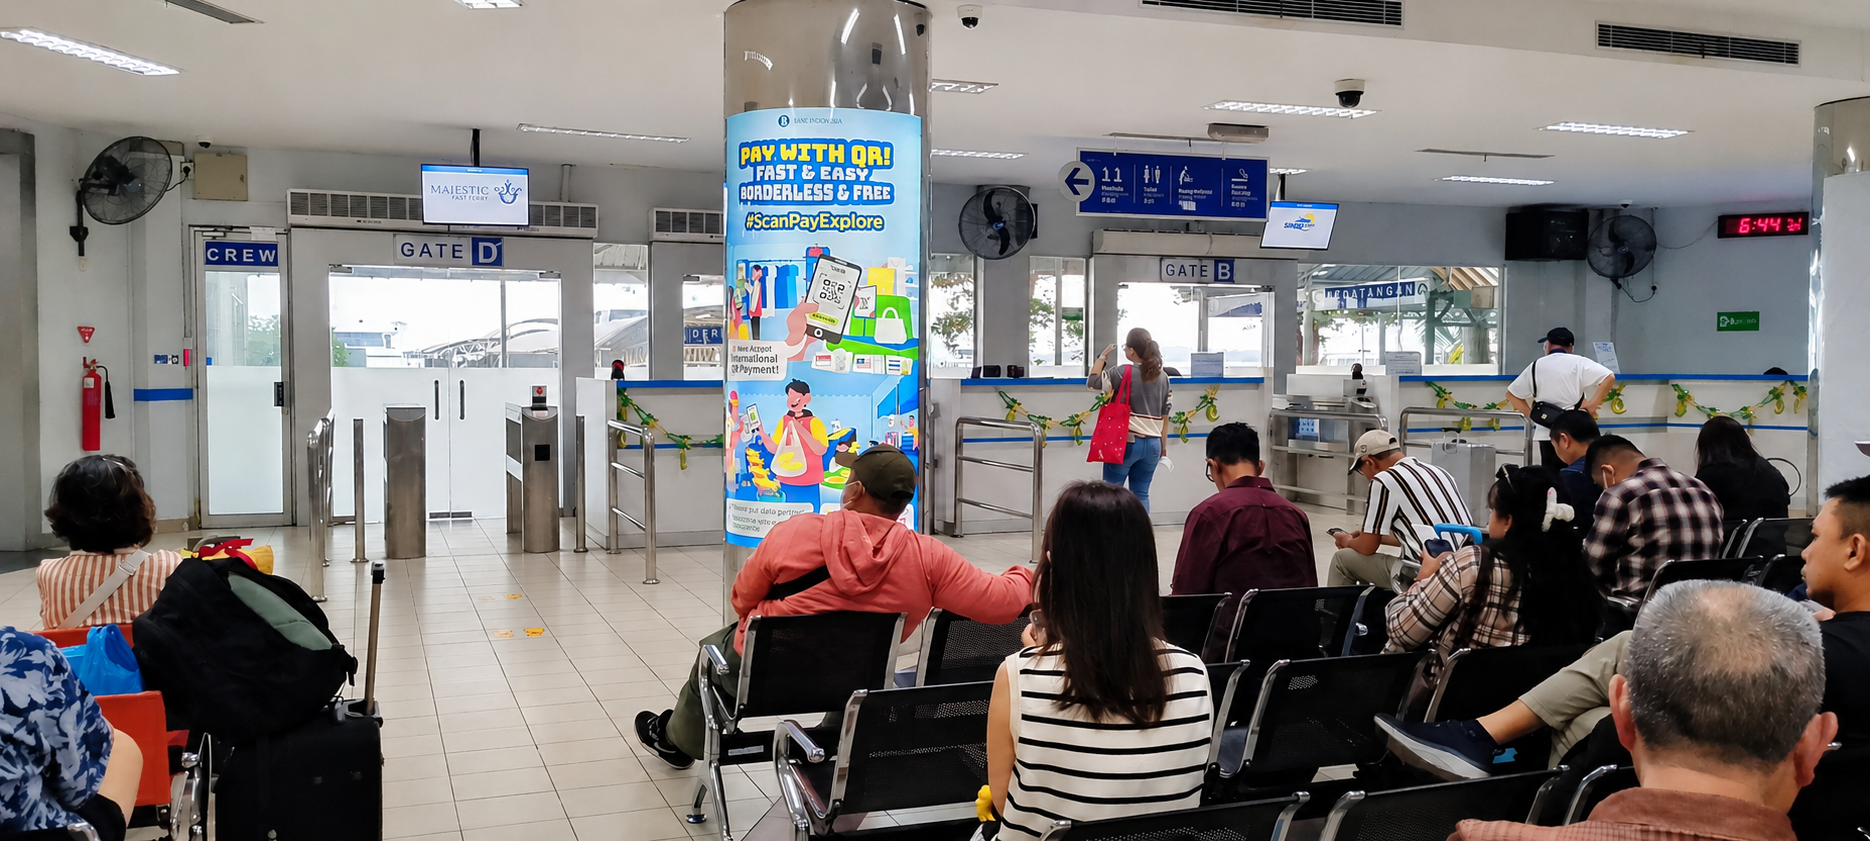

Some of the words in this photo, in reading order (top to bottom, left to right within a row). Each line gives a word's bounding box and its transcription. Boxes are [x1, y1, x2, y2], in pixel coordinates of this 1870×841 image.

[741, 144, 775, 165] PAY
[780, 143, 845, 163] WITH
[851, 145, 891, 168] QR!
[756, 165, 798, 182] FAST
[801, 164, 815, 180] &
[820, 166, 869, 181] EASY
[740, 184, 834, 201] BORDERLESS
[837, 184, 850, 201] &
[853, 184, 891, 201] FREE
[746, 212, 883, 231] #ScanPayExplore
[1739, 217, 1781, 234] 6:44
[206, 247, 276, 263] CREW
[401, 241, 463, 260] GATE
[478, 242, 499, 264] D
[1165, 263, 1208, 278] GATE
[1218, 262, 1231, 280] B
